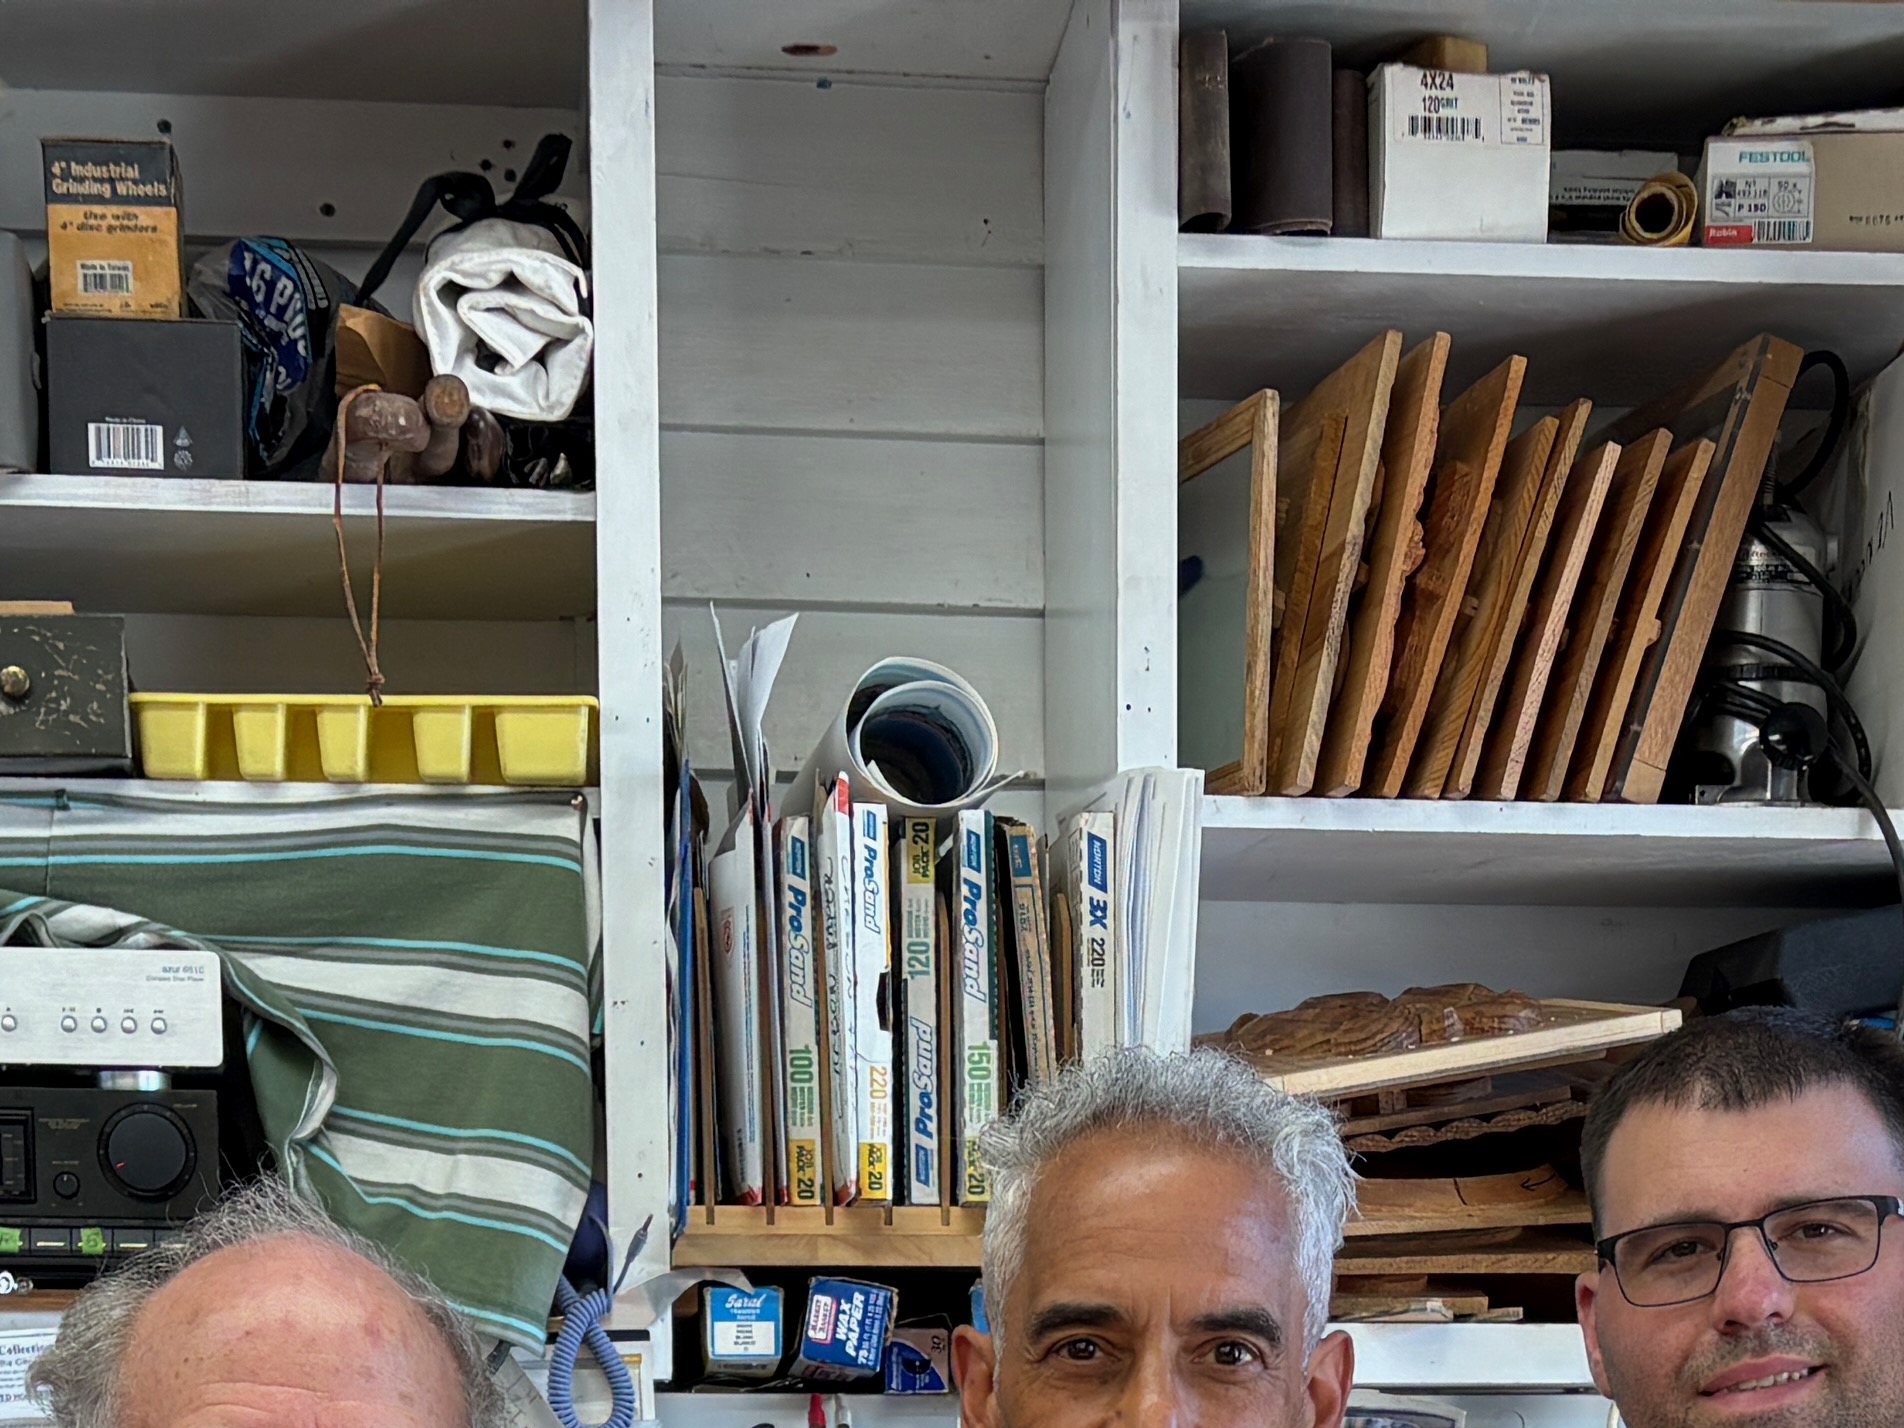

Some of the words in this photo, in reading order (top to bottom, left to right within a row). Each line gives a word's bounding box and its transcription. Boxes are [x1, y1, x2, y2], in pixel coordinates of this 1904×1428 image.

[1420, 71, 1455, 92] 4X24
[1422, 96, 1441, 114] 120
[71, 162, 140, 180] Industrial
[1739, 151, 1810, 163] FESTOOL
[52, 179, 112, 198] Grinding
[116, 180, 167, 197] Wheels
[913, 821, 930, 845] 20
[921, 847, 930, 877] PACK
[1092, 839, 1103, 885] NORTON
[864, 844, 881, 934] ProSand
[1089, 896, 1108, 930] 3X
[787, 885, 813, 1009] ProSand
[964, 878, 983, 1001] ProSand
[1091, 937, 1105, 967] 220
[907, 939, 931, 978] 120
[789, 1046, 814, 1089] 100
[967, 1042, 991, 1082] 150
[870, 1066, 887, 1099] 220
[915, 1018, 934, 1139] ProSand
[797, 1177, 815, 1200] 20
[868, 1171, 883, 1191] 20
[968, 1172, 986, 1195] 20
[836, 1299, 852, 1340] WAX
[846, 1292, 865, 1356] PAPER
[857, 1349, 869, 1365] 75
[931, 1336, 943, 1353] 30
